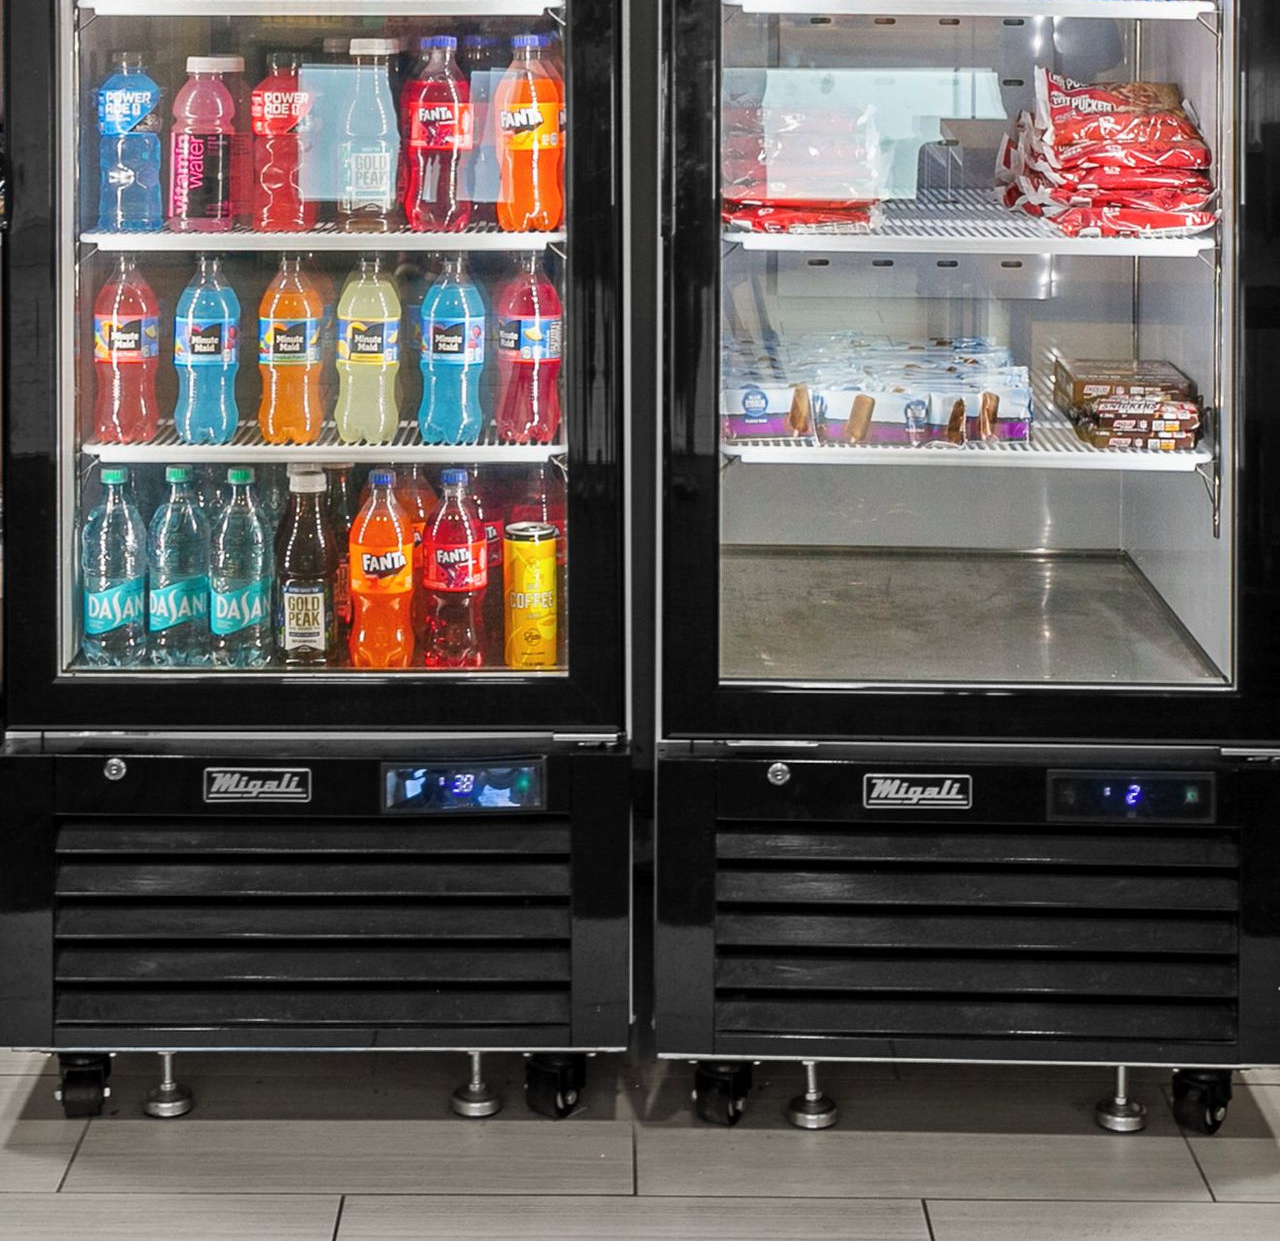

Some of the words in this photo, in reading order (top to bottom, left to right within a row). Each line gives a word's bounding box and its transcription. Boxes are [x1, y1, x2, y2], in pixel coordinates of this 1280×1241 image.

[105, 92, 151, 104] POWER
[264, 92, 308, 104] POWER
[419, 107, 454, 123] FANTA
[500, 108, 544, 128] FANTA
[189, 136, 205, 189] water
[355, 155, 387, 171] GOLD
[173, 133, 189, 215] vitamin
[191, 335, 219, 345] Minute
[276, 335, 304, 344] Minute
[354, 334, 382, 344] Minute
[435, 334, 463, 344] Minute
[194, 343, 215, 352] Maid
[279, 343, 300, 351] Maid
[357, 343, 379, 351] Maid
[438, 343, 459, 351] Maid
[362, 551, 407, 572] FANTA
[88, 589, 144, 624] DASAN
[216, 589, 269, 624] DASAN
[288, 596, 320, 611] GOLD
[510, 590, 553, 609] COFFEE
[288, 612, 320, 626] PEAK
[209, 771, 305, 798] Migali
[870, 777, 966, 804] Migali
